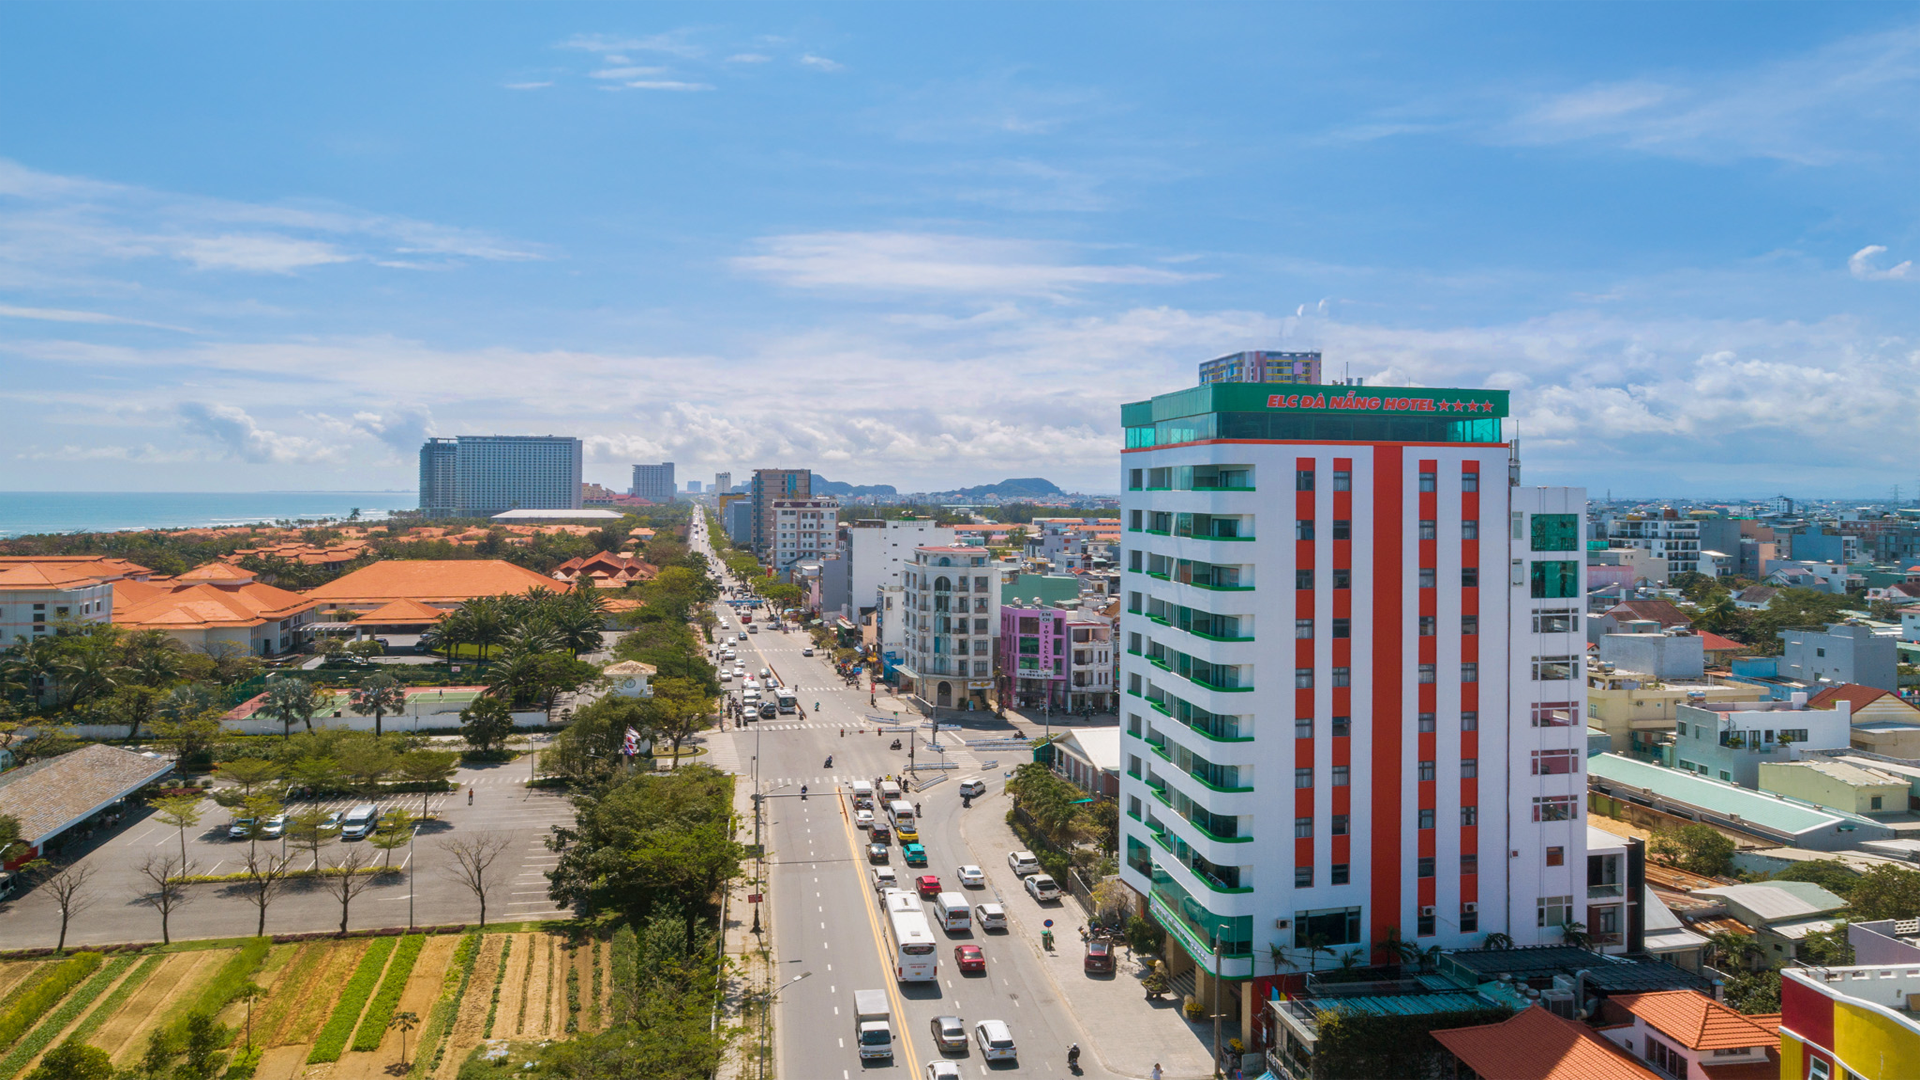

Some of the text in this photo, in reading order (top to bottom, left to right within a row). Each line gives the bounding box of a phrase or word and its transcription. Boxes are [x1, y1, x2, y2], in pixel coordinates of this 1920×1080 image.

[1267, 394, 1299, 408] ELC
[1300, 392, 1326, 409] ĐÀ
[1383, 397, 1437, 411] HOTEL
